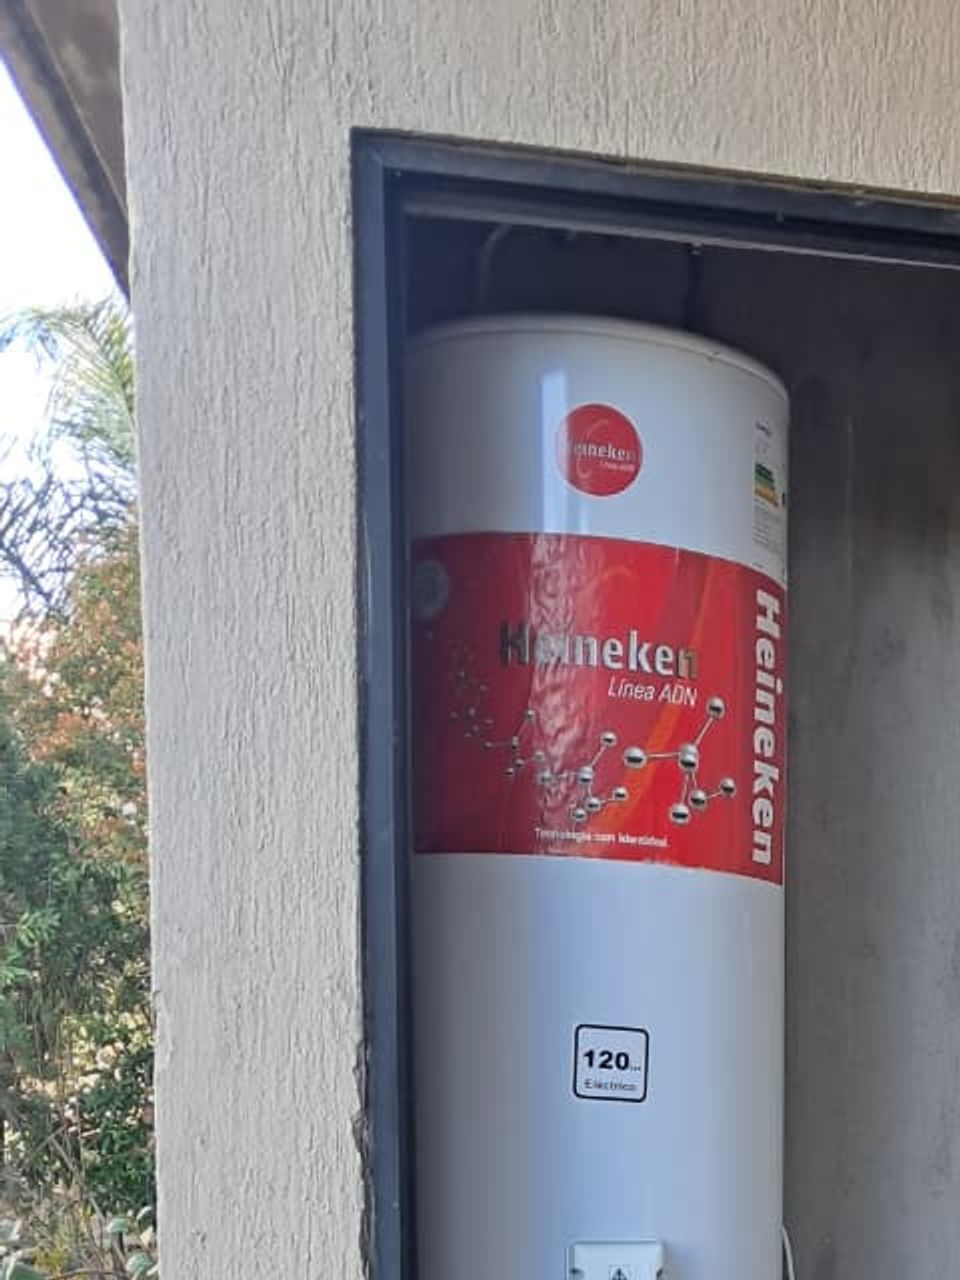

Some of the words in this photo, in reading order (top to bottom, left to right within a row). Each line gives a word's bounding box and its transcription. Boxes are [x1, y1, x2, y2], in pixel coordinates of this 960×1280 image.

[658, 683, 697, 706] ADN
[752, 589, 783, 864] Heineken
[584, 1050, 629, 1070] 120
